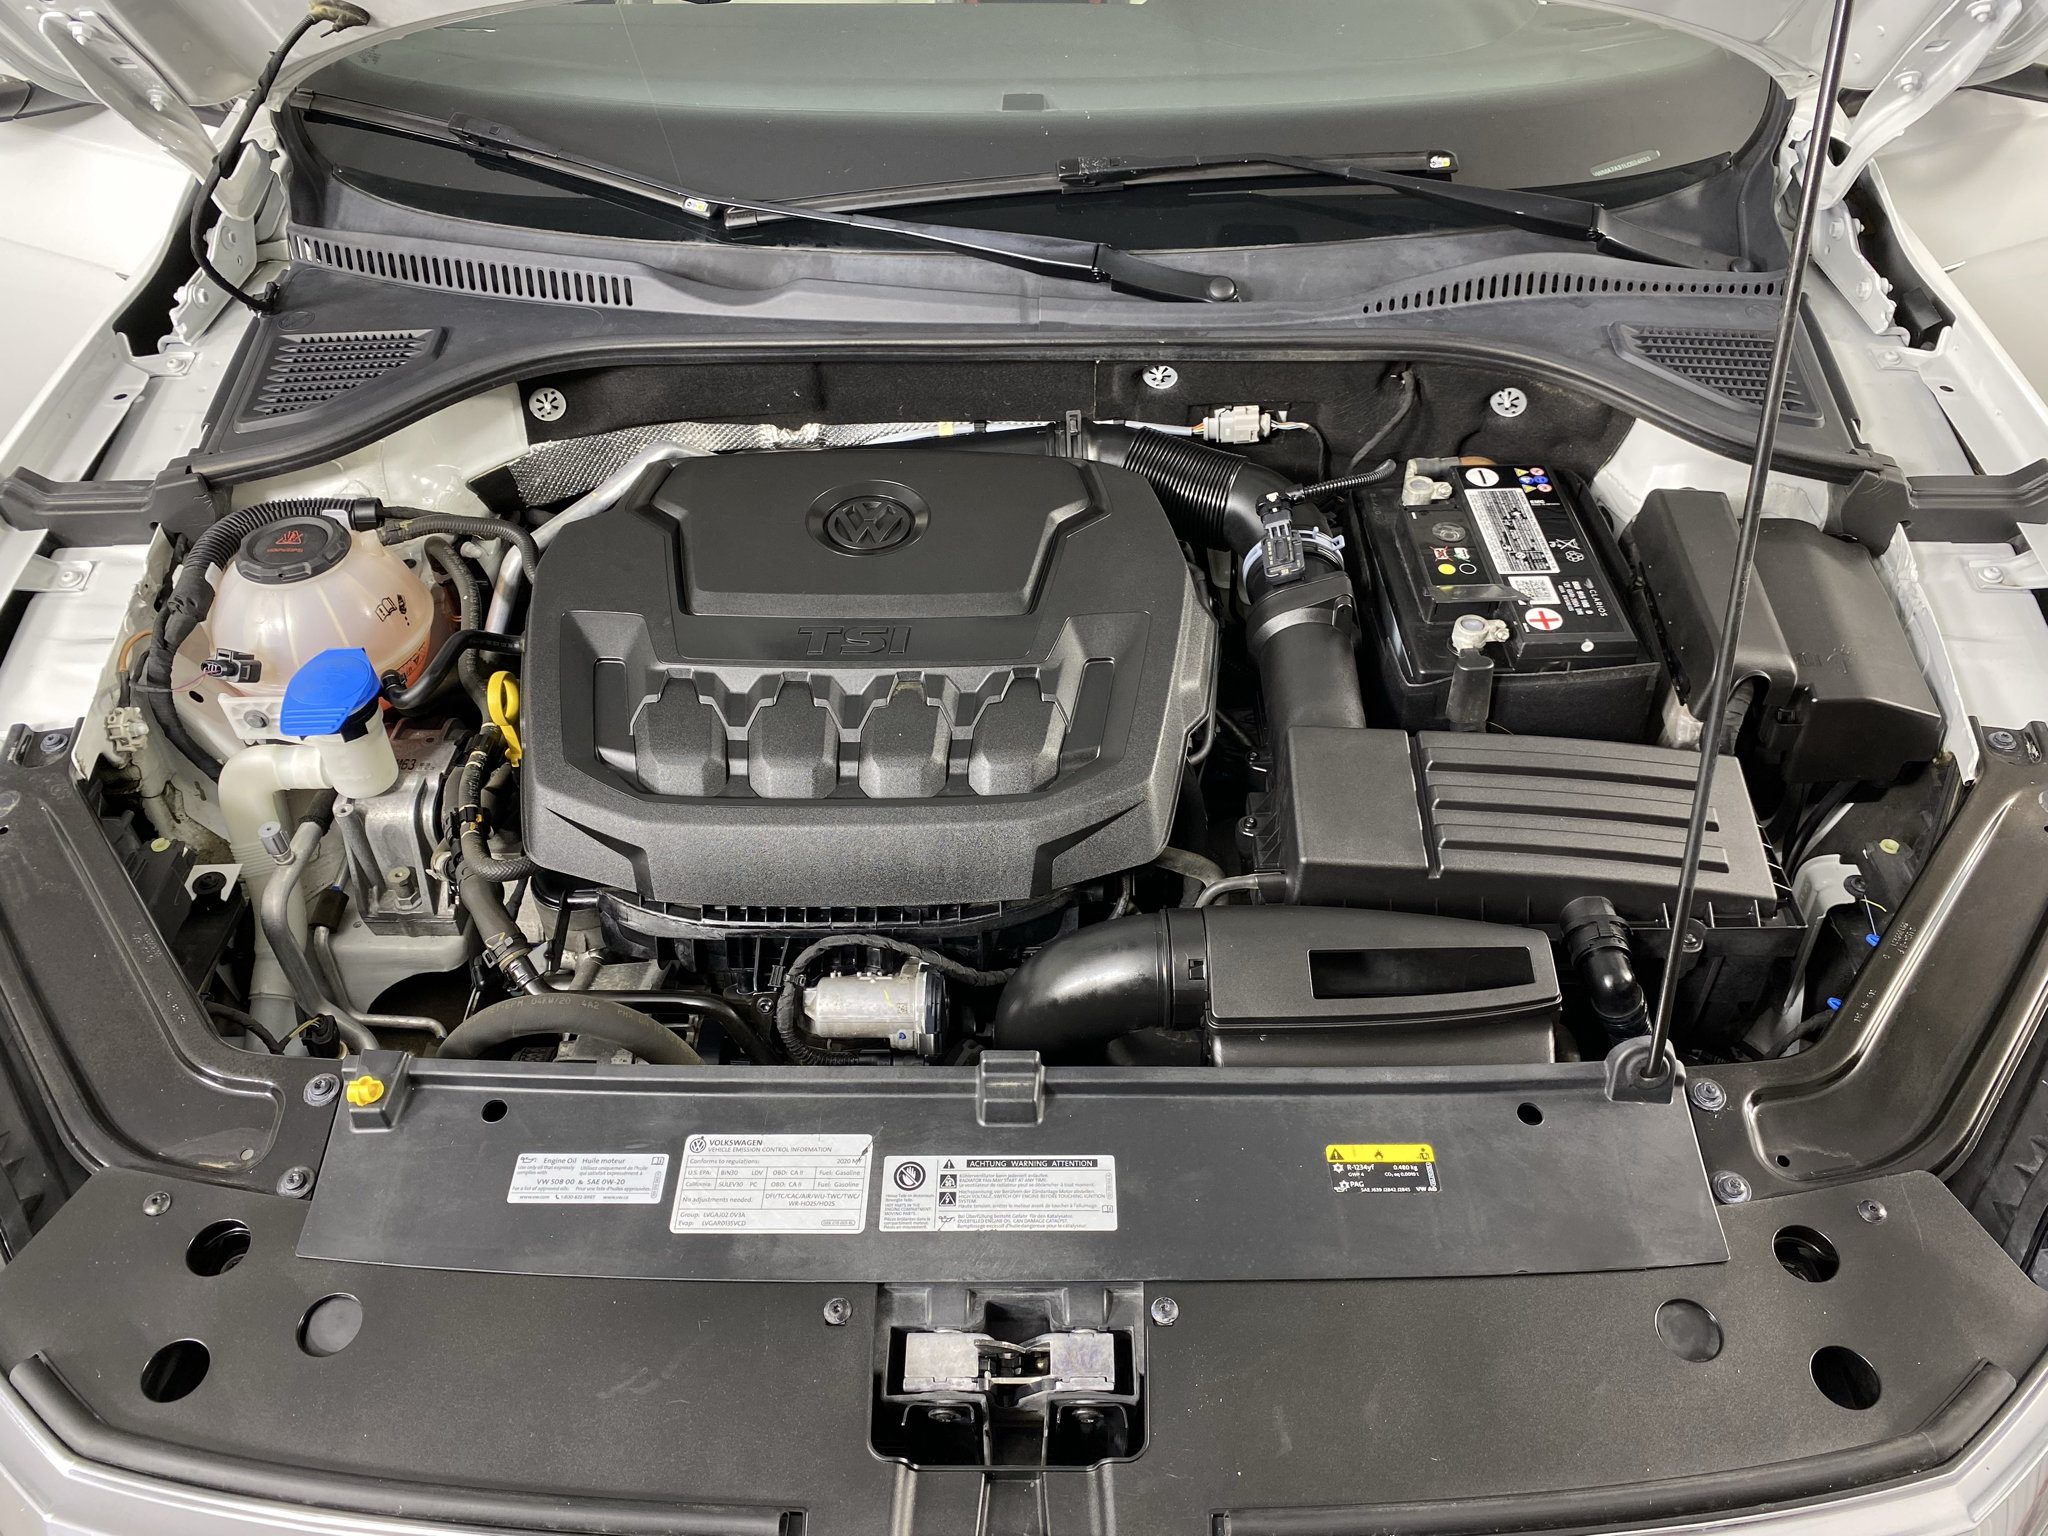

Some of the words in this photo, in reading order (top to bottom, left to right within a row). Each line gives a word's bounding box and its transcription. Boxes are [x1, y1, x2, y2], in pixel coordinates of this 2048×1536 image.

[1589, 589, 1608, 617] CLARIOS
[798, 626, 912, 656] TSI
[543, 1158, 566, 1166] Engine
[1346, 1164, 1375, 1172] R-1234yf
